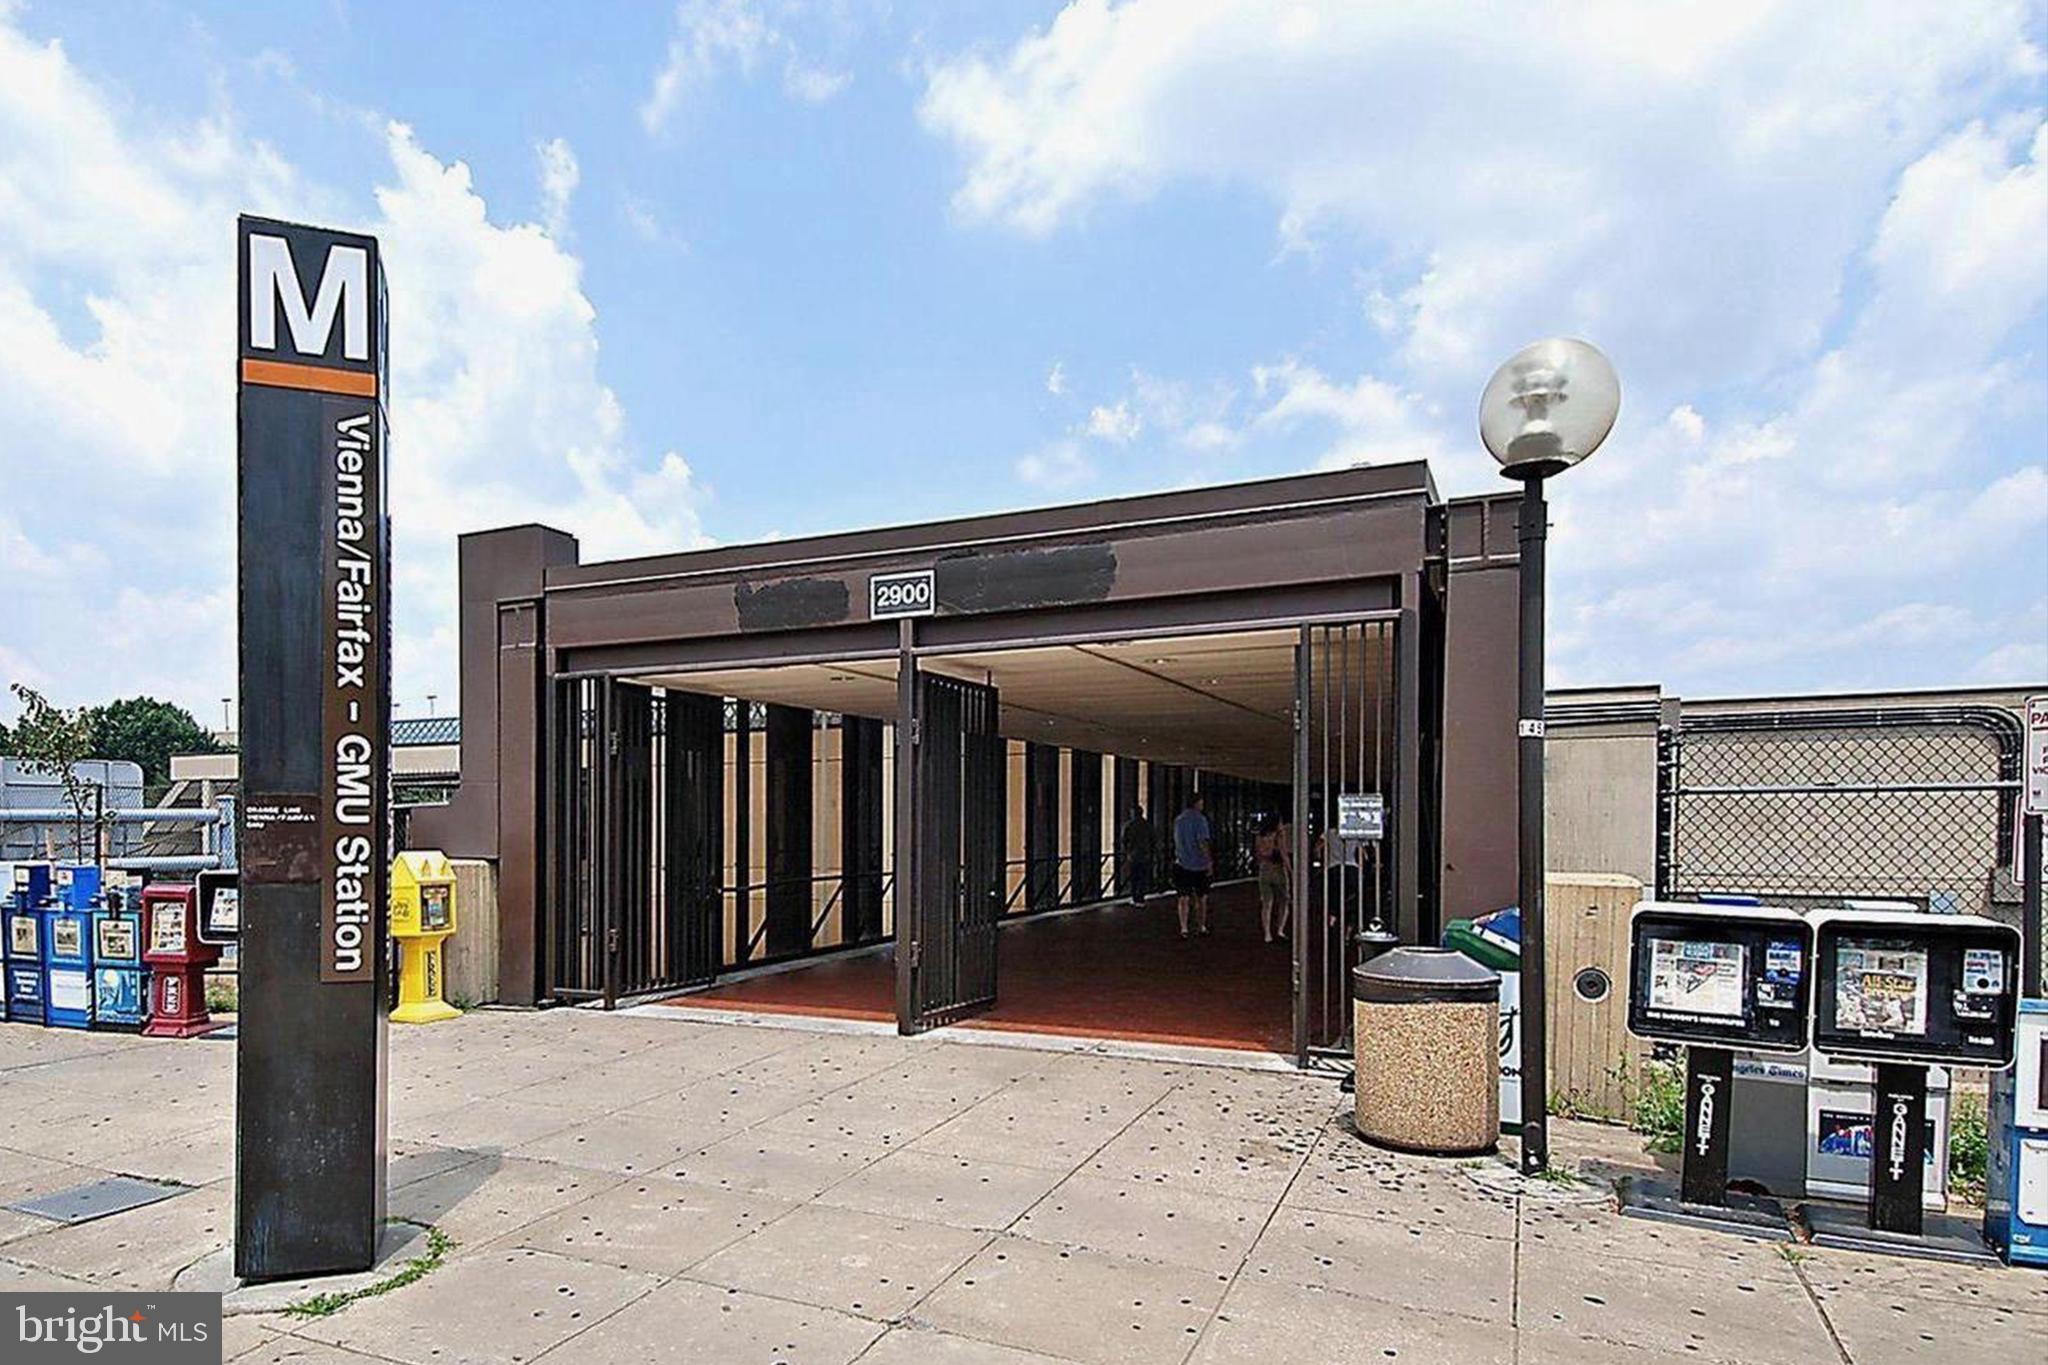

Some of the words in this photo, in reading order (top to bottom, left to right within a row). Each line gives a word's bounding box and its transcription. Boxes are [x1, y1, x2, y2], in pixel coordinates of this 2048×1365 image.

[249, 233, 368, 361] M
[337, 414, 371, 688] Vienna/Fairfax
[877, 583, 929, 607] 2900
[336, 735, 371, 825] GMU
[335, 836, 371, 971] Station
